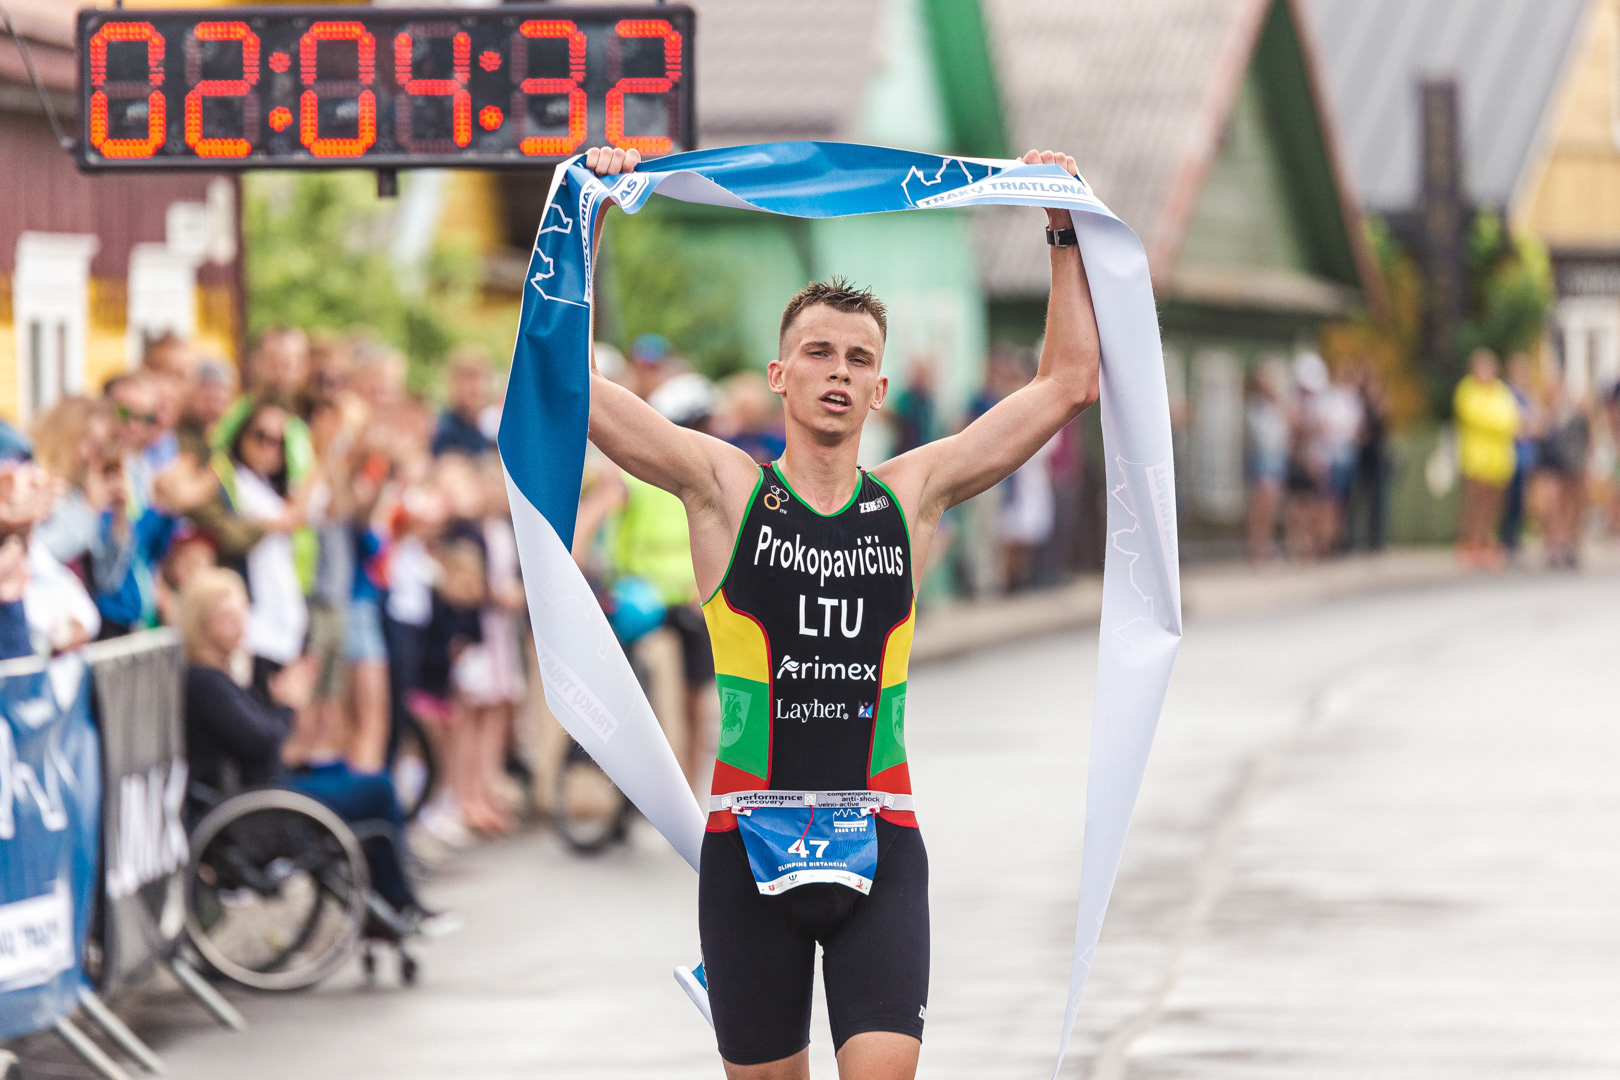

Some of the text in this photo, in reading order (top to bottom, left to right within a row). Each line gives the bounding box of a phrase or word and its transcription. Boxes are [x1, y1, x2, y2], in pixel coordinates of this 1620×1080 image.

[90, 19, 683, 158] 02:04:32
[619, 179, 638, 201] AS
[921, 185, 984, 207] TRAKŲ
[753, 524, 904, 587] Prokopavičius
[798, 594, 864, 638] LTU
[776, 654, 877, 682] Arimex
[736, 793, 803, 803] performance
[787, 839, 830, 859] 47
